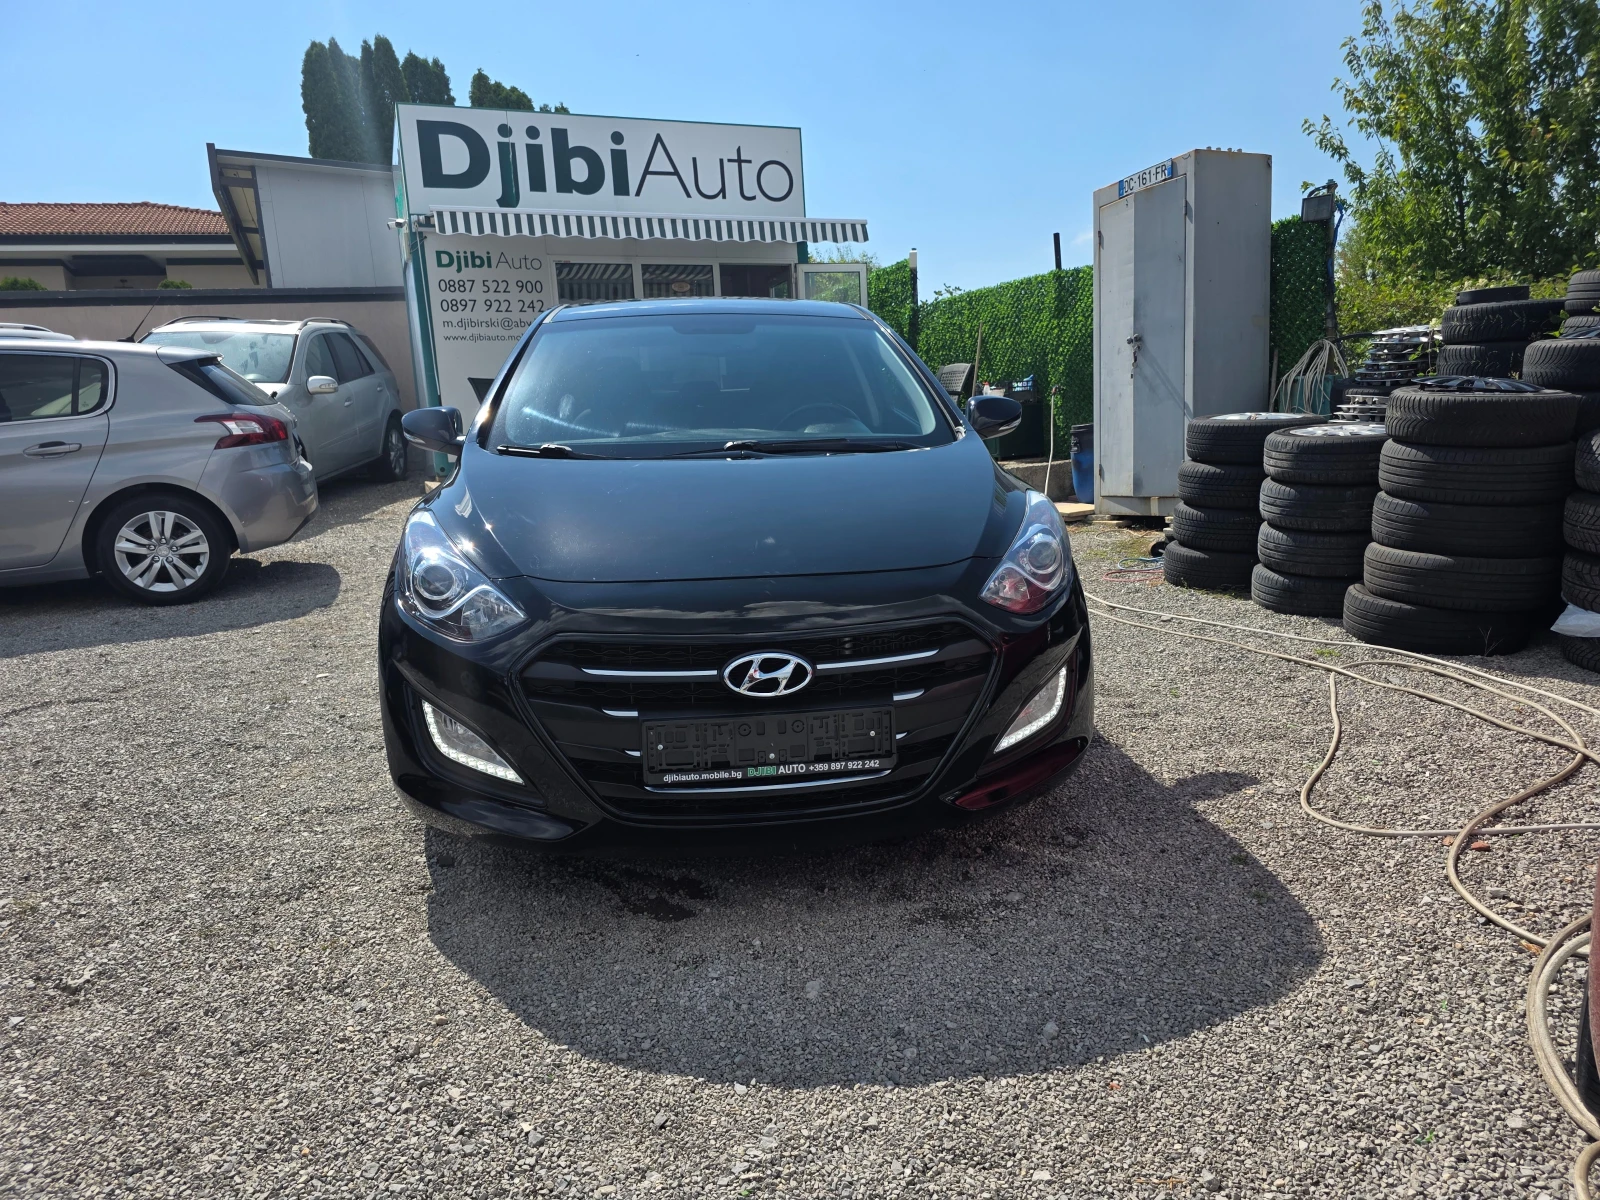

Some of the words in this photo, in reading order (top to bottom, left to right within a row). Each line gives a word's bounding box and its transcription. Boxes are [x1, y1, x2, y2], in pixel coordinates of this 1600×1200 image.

[438, 278, 475, 293] 0887
[482, 279, 511, 294] 522
[515, 280, 543, 294] 900
[440, 298, 477, 313] 0897
[484, 299, 513, 313] 922
[517, 299, 545, 313] 242
[442, 317, 537, 331] m.djibirski@abv
[443, 333, 524, 344] www.djibiauto.mo
[663, 770, 743, 783] djibiauto.mobile.bg
[747, 765, 777, 777] DJIBI
[778, 763, 806, 775] AUTO
[809, 763, 829, 772] +359
[830, 761, 846, 770] 897
[847, 760, 863, 769] 922
[864, 759, 880, 768] 242
